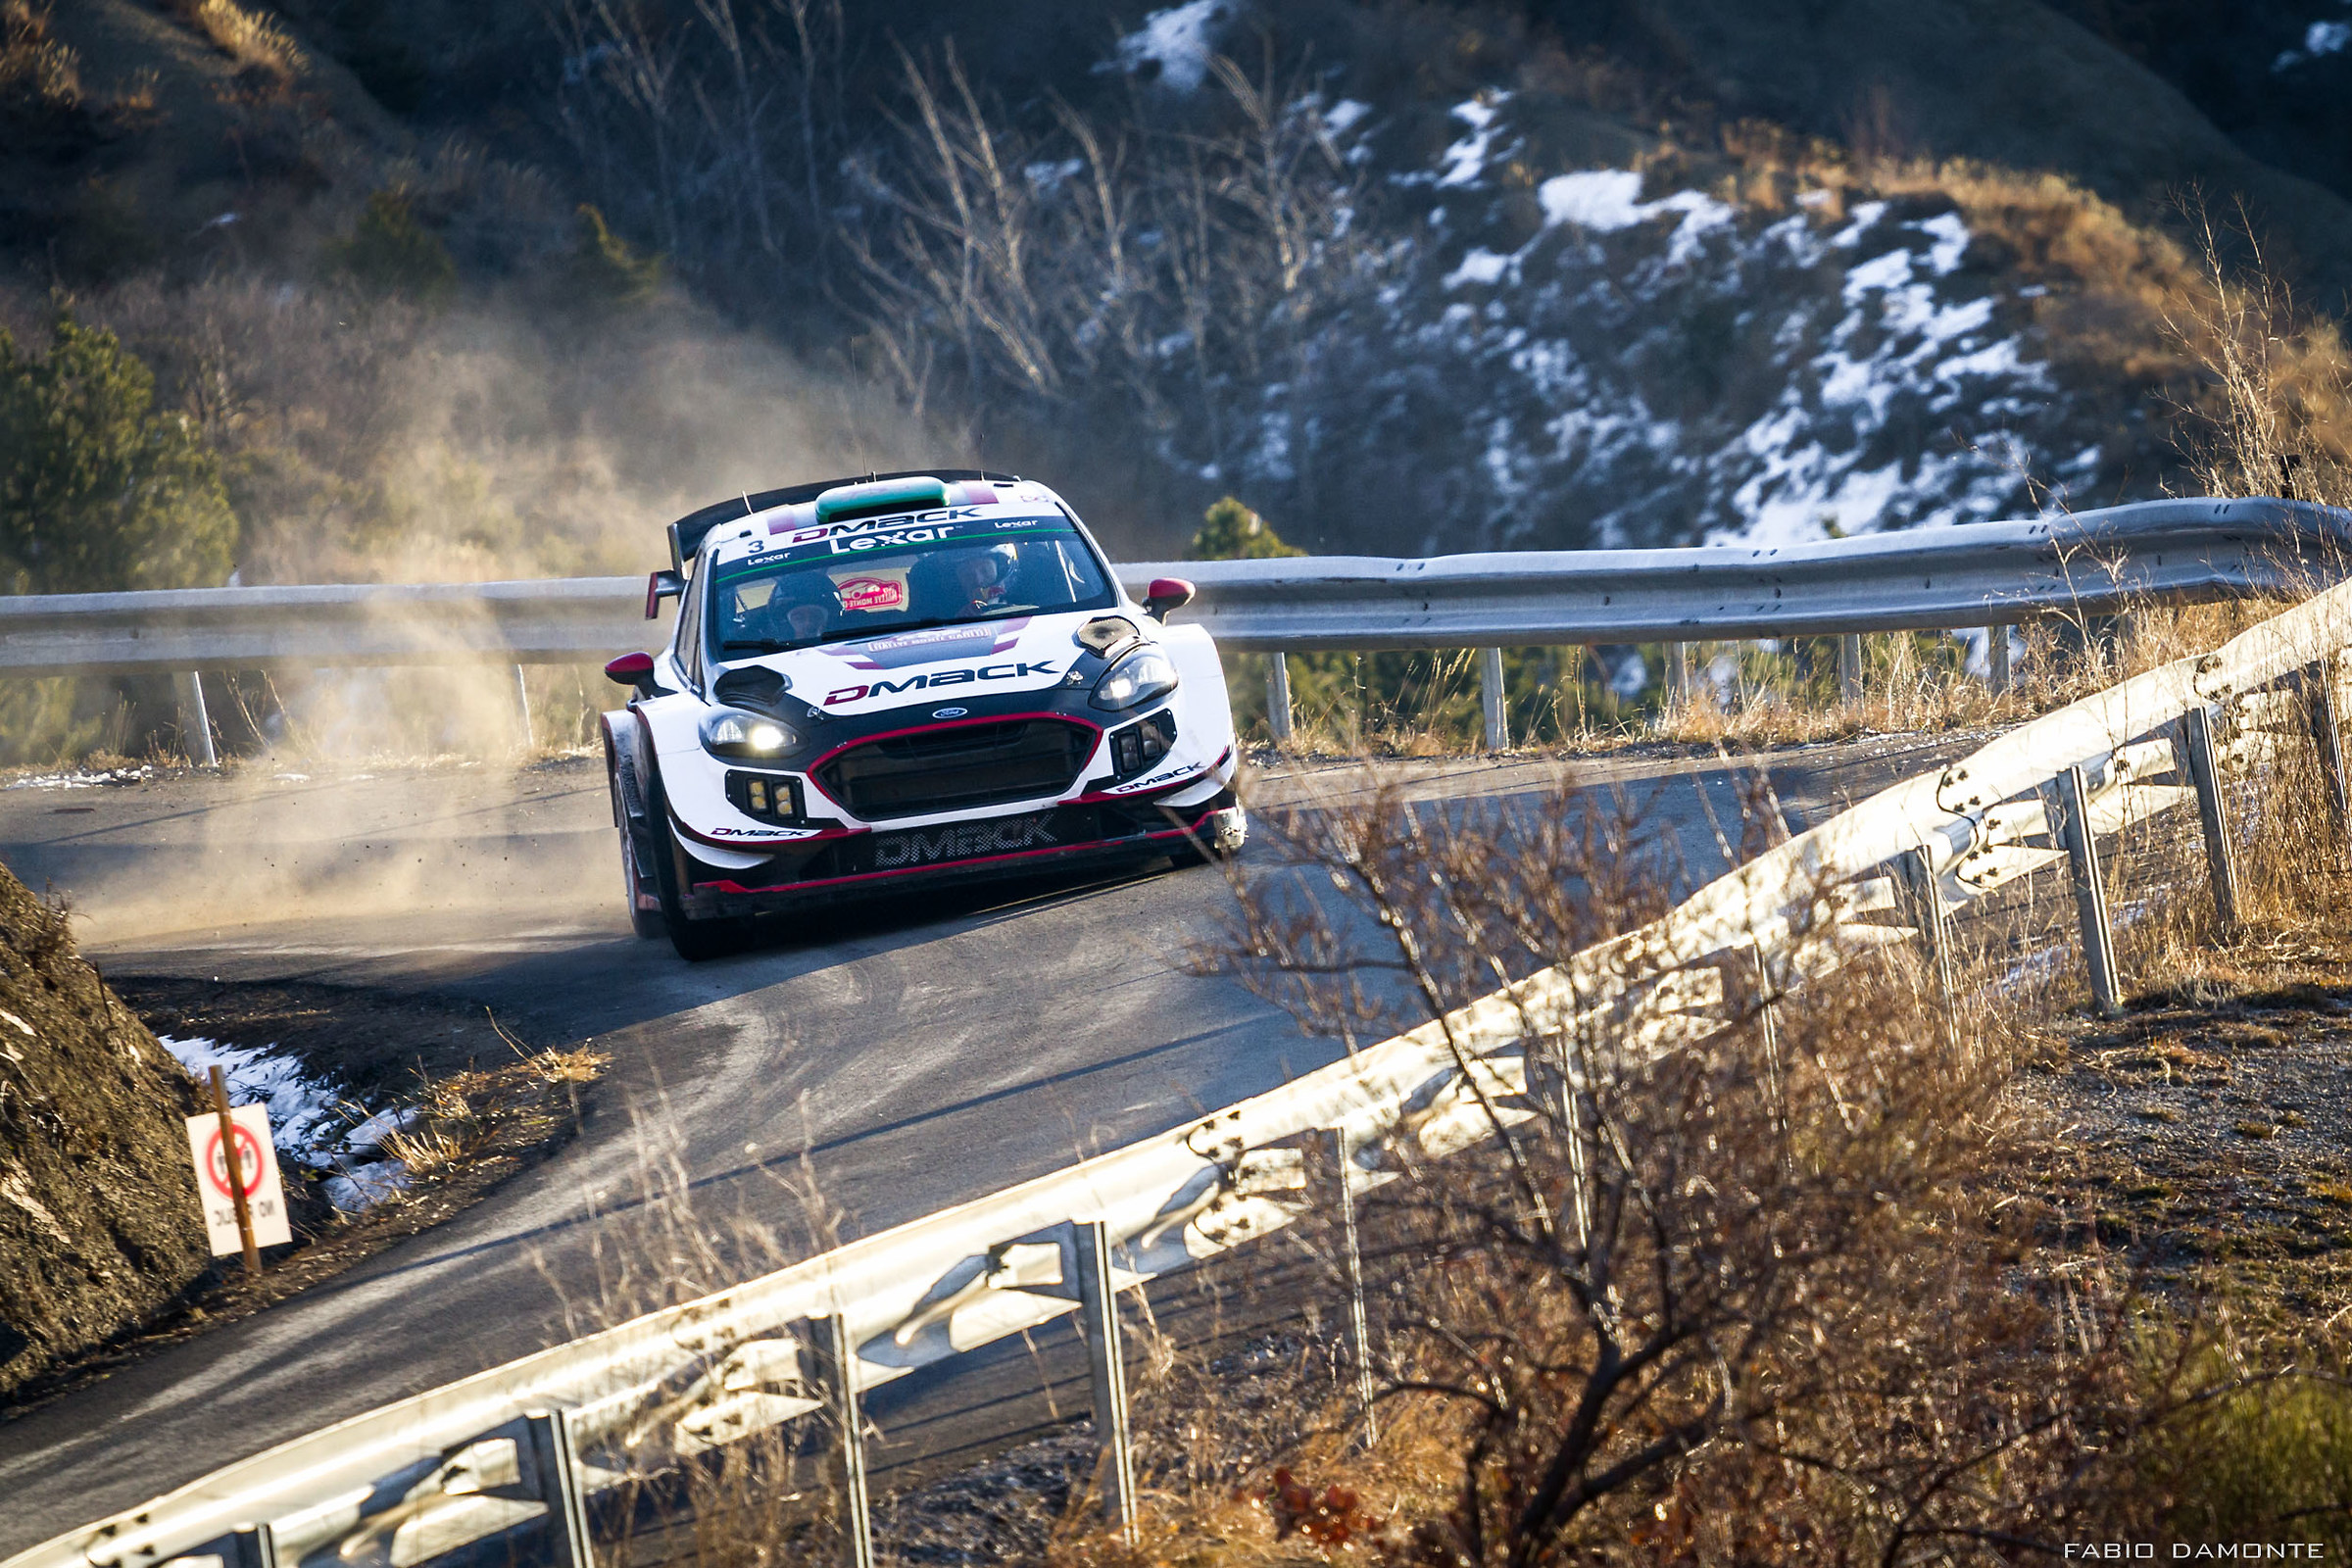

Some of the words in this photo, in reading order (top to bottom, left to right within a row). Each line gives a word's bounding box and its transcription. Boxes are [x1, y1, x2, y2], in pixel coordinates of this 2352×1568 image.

[994, 518, 1038, 529] Lexar
[831, 524, 956, 555] Lexar
[748, 540, 764, 554] 3
[747, 551, 791, 566] Lexar
